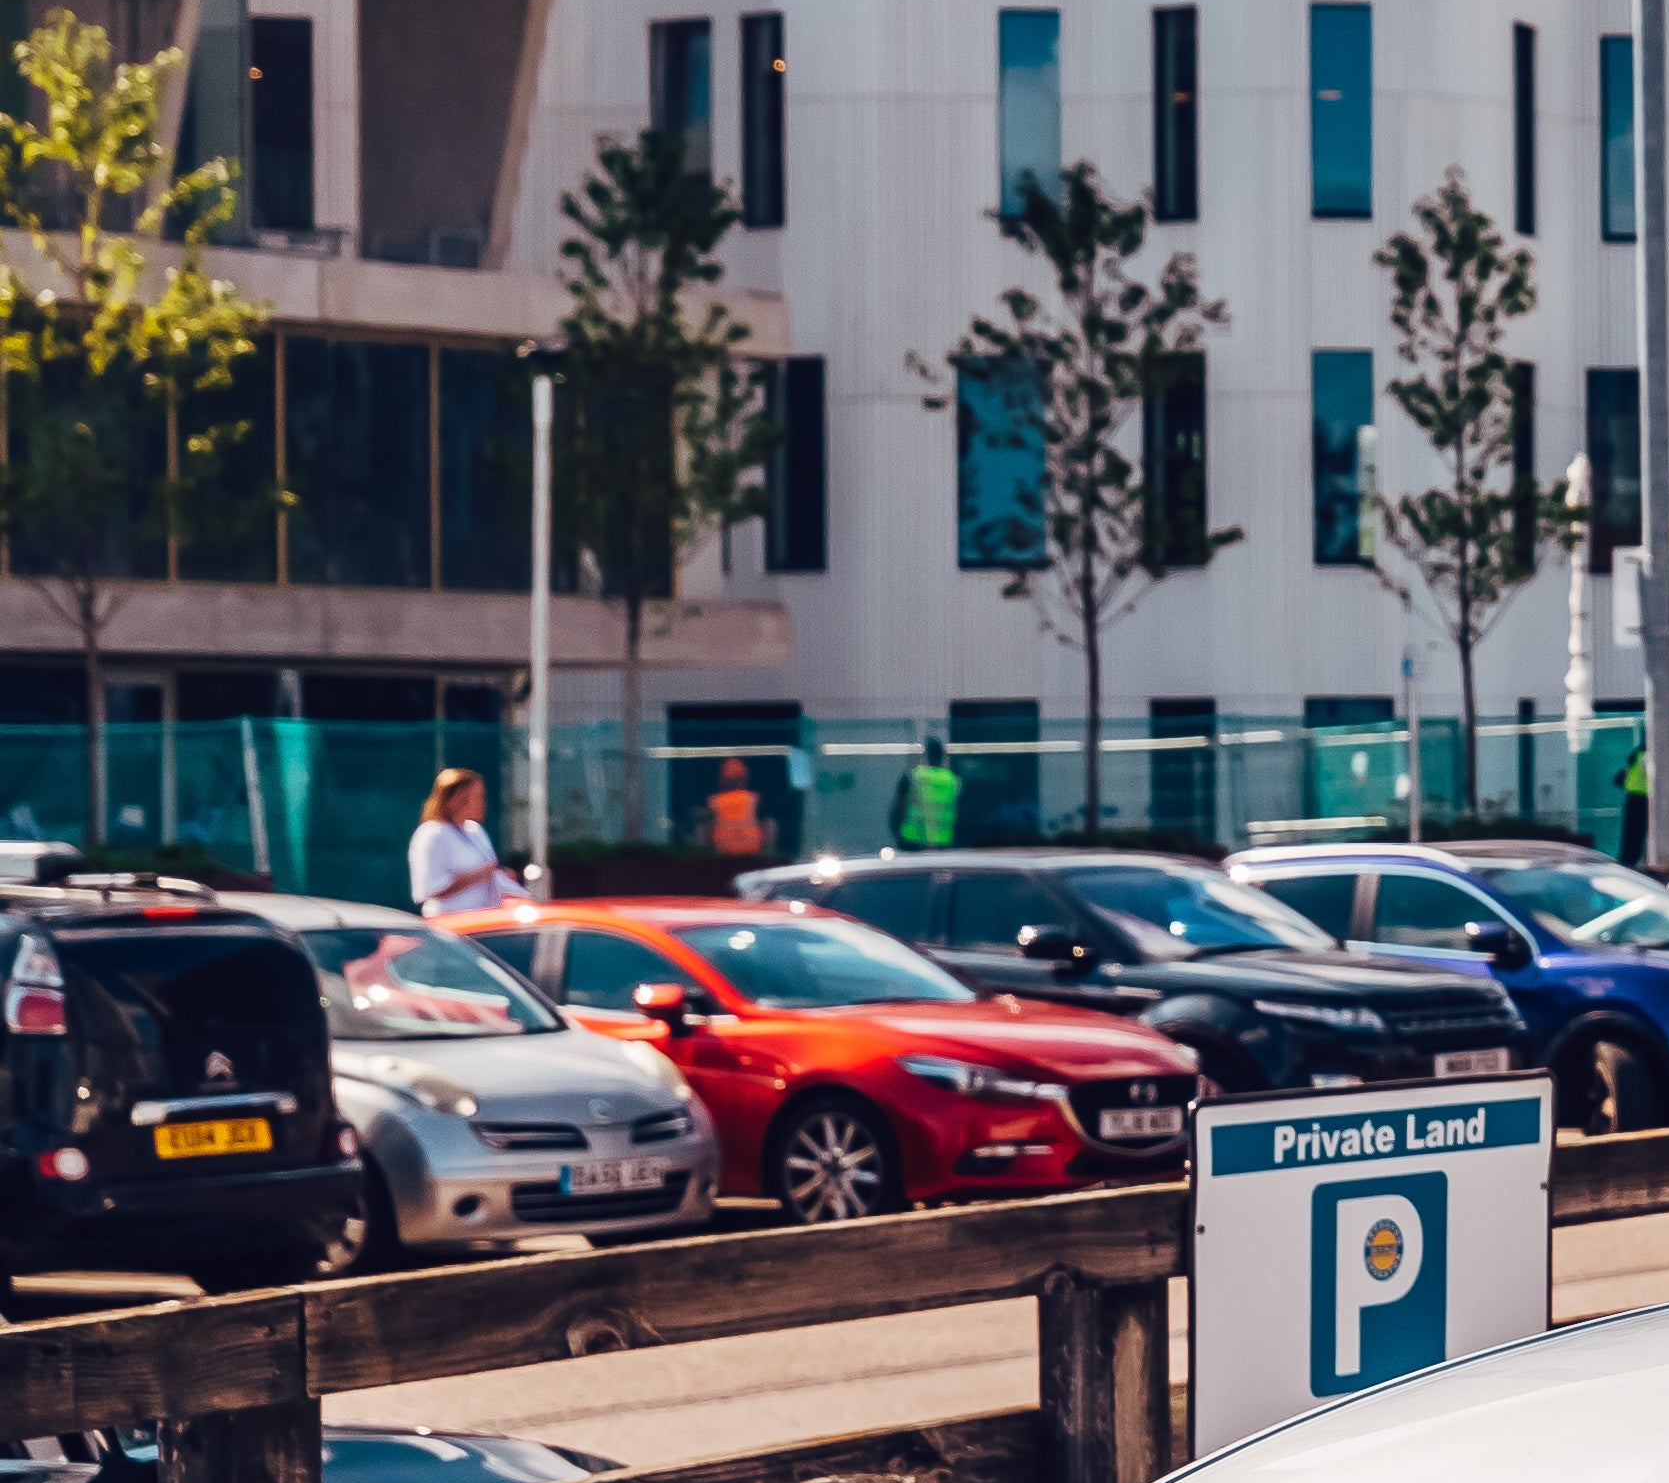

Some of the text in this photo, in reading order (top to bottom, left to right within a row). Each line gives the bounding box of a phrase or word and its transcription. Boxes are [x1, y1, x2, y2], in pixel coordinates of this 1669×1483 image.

[1273, 1107, 1486, 1164] Private Land
[1335, 1194, 1423, 1377] P
